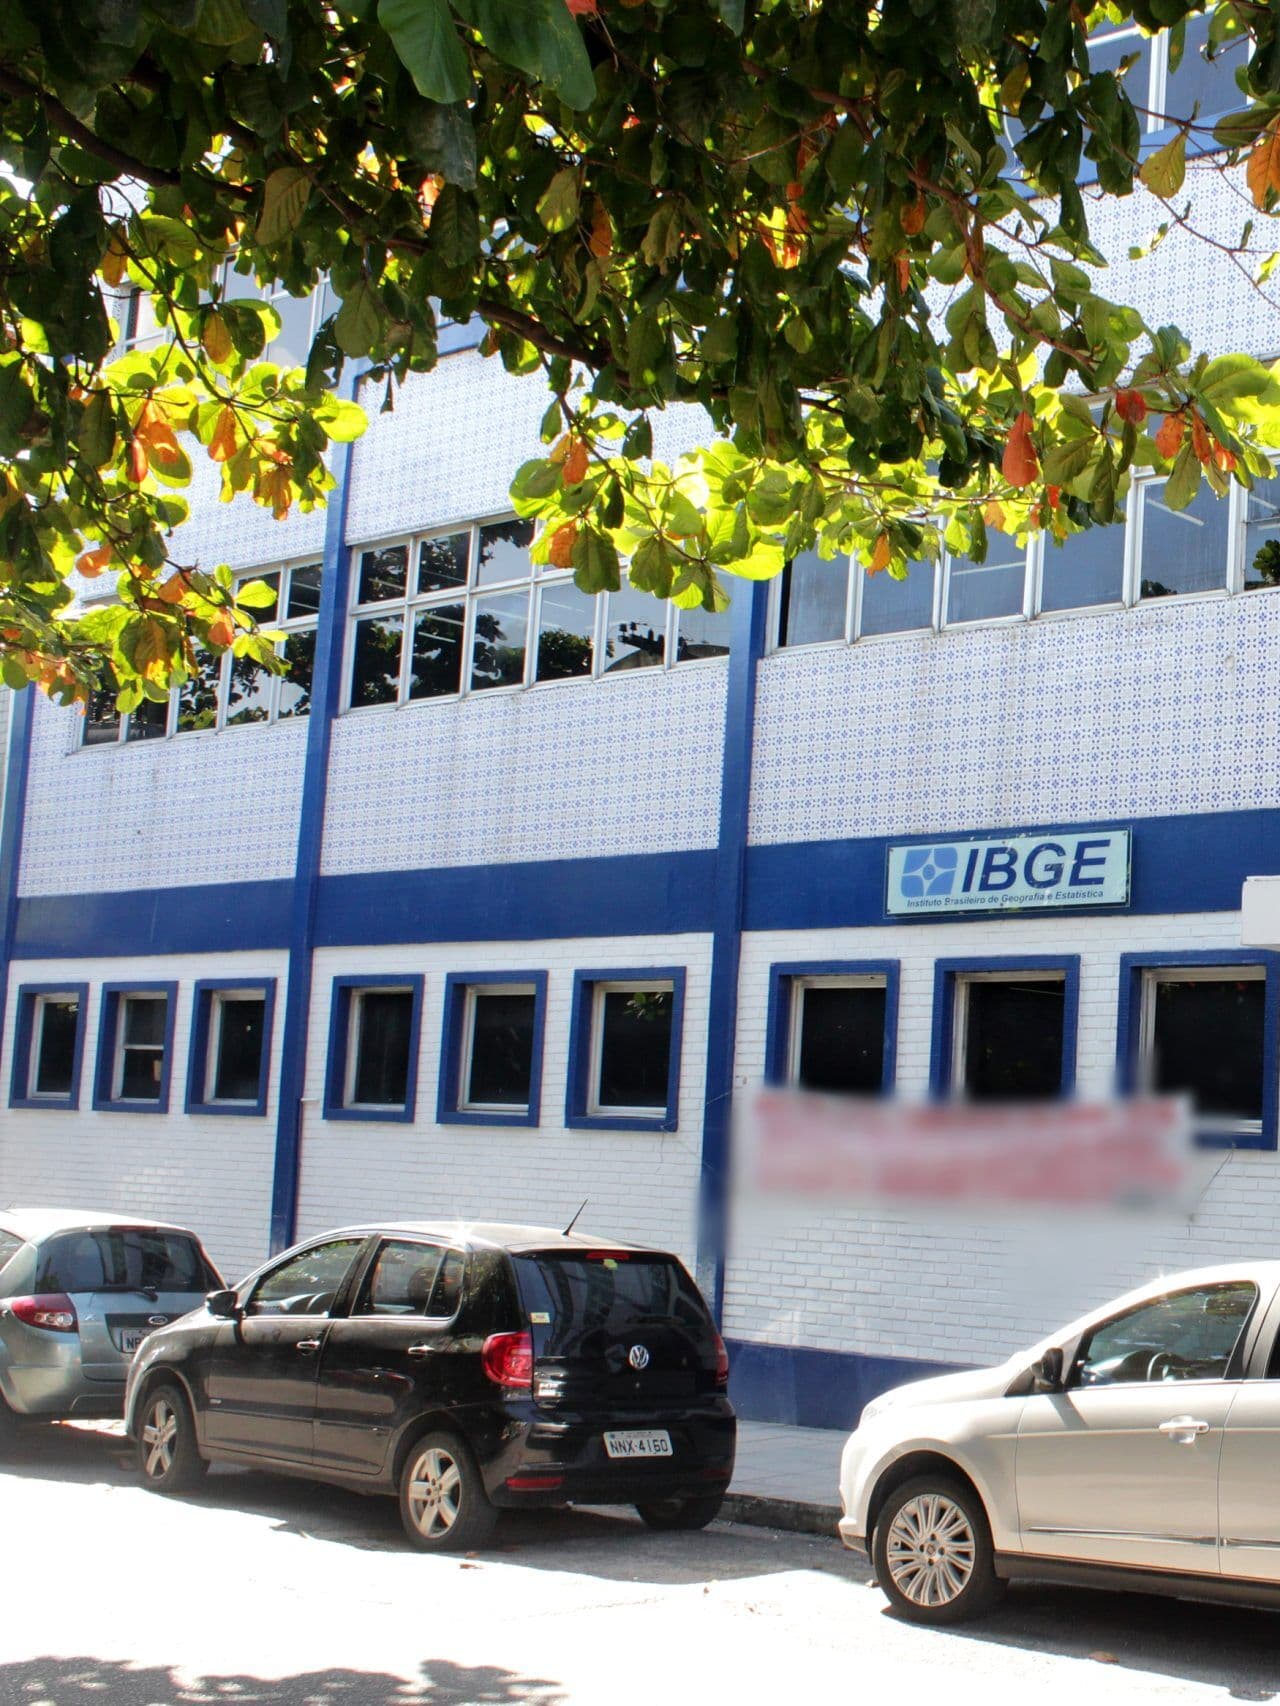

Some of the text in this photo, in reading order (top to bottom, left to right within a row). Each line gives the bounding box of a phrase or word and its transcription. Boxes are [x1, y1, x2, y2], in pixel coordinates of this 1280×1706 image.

[962, 839, 1111, 893] IBGE
[907, 898, 942, 908] Instituto
[944, 896, 986, 906] Brasileiro
[987, 895, 998, 904] de
[1001, 892, 1045, 904] Geografia
